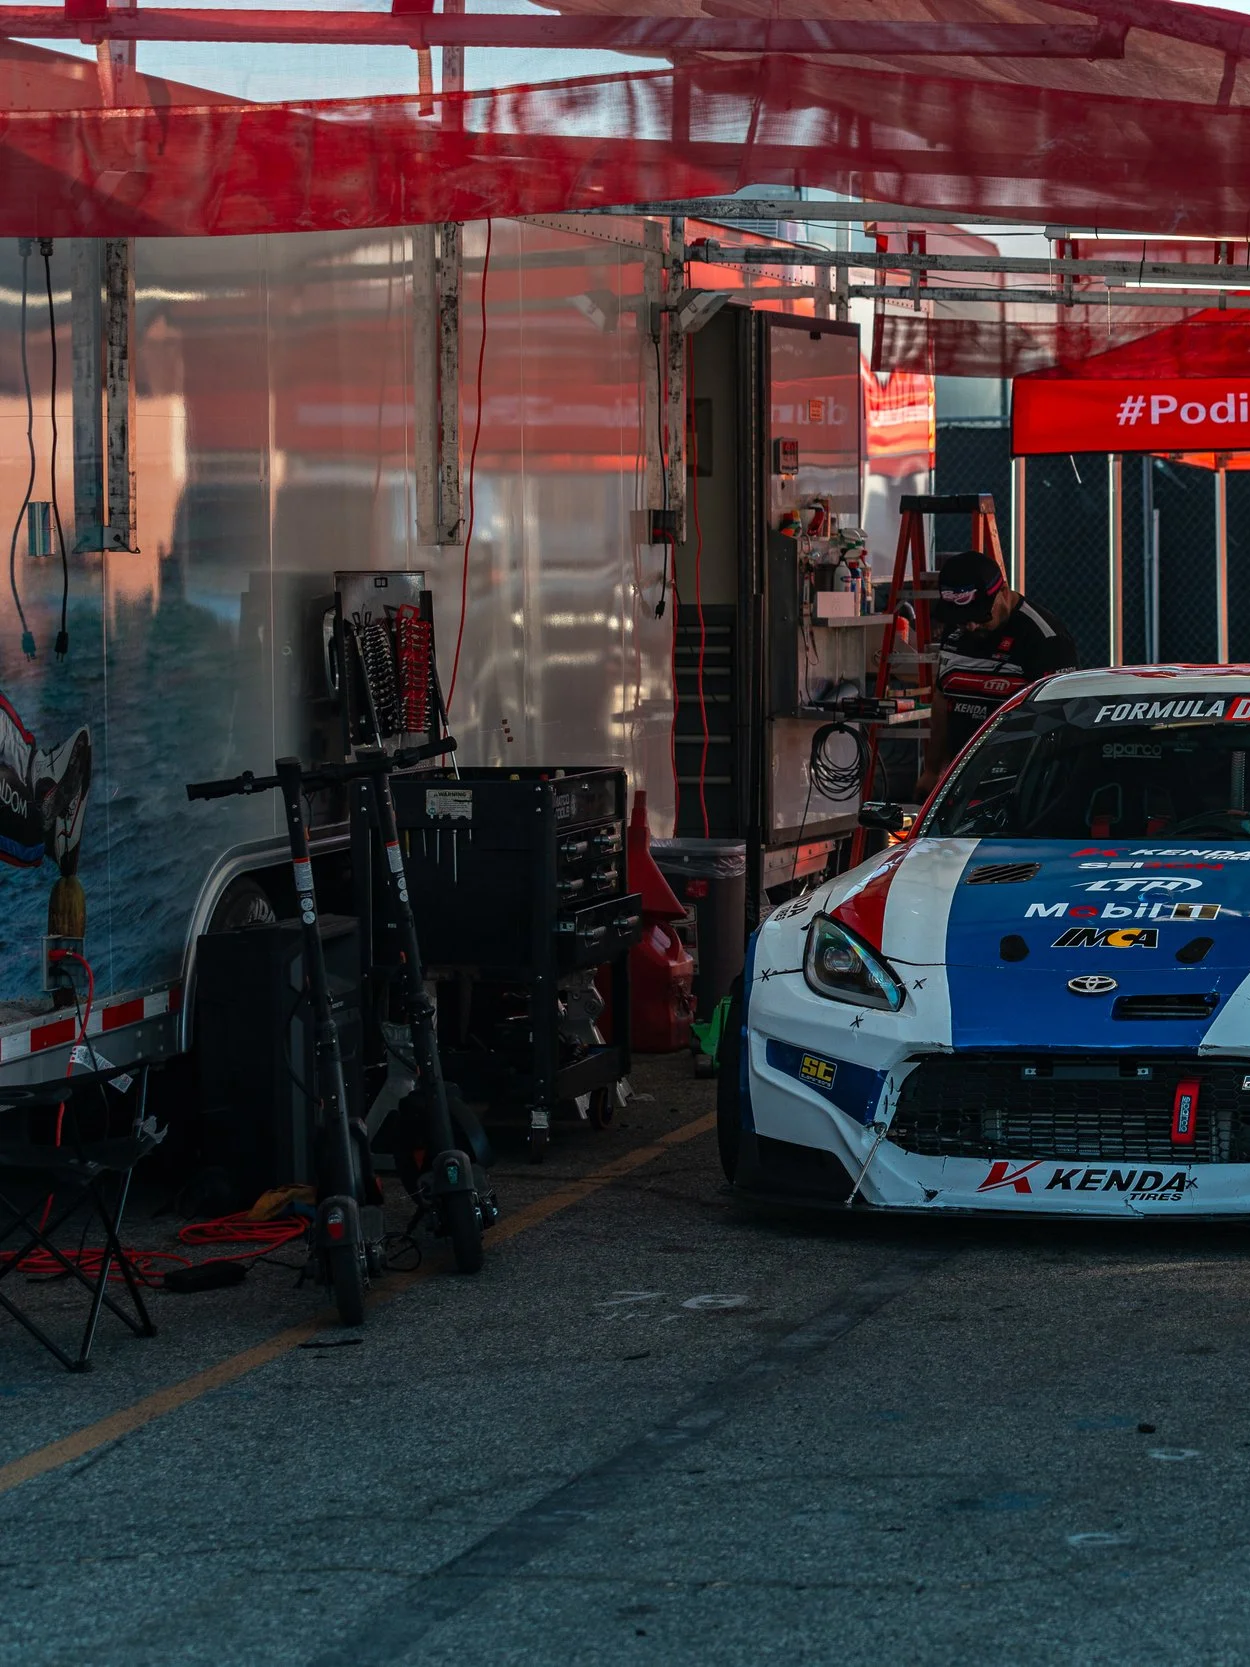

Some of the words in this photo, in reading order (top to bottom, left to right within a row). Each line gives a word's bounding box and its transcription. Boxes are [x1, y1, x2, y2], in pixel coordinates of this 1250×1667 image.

[954, 703, 988, 714] KENDA
[1095, 700, 1227, 723] FORMULA
[1024, 902, 1163, 918] Mobil
[1045, 1168, 1187, 1192] KENDA
[1129, 1192, 1183, 1201] TIRES
